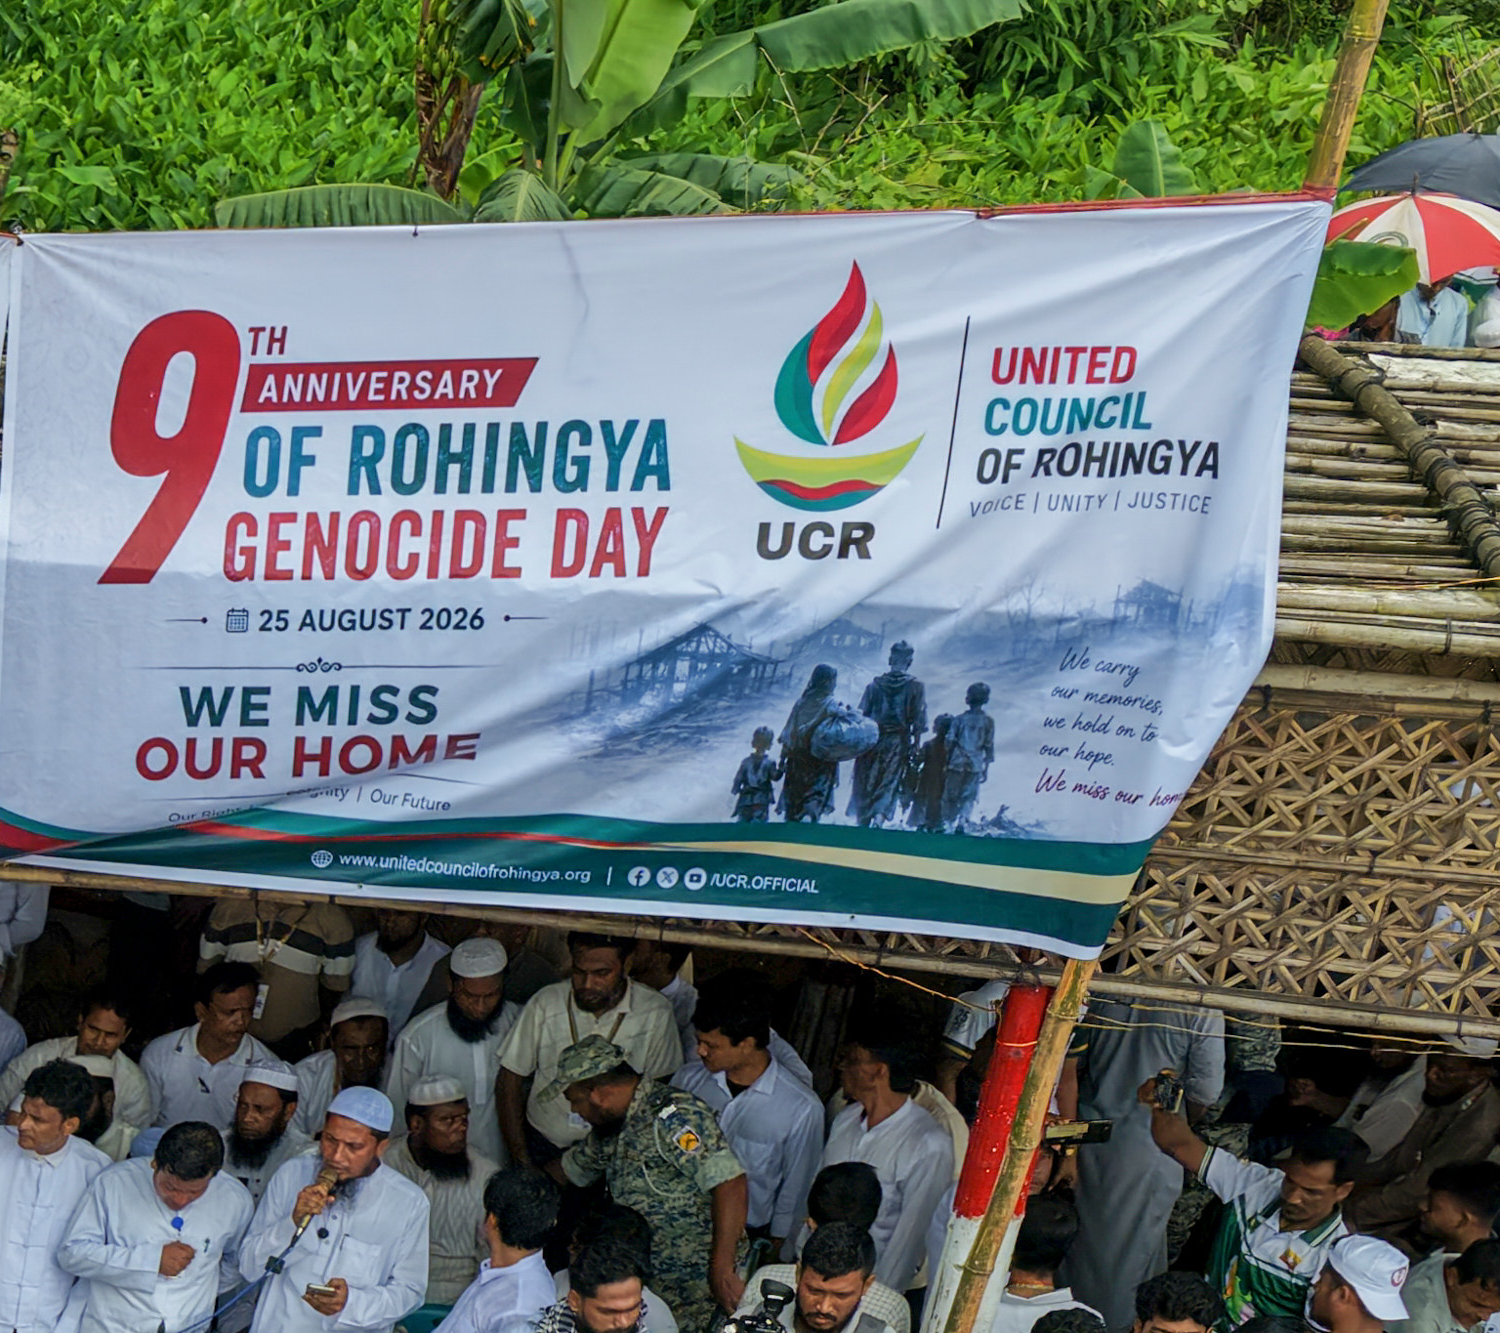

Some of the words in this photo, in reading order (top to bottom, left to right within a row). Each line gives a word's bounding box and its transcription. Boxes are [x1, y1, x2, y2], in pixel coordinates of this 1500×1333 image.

[247, 325, 288, 356] TH
[991, 346, 1138, 386] UNITED
[258, 368, 504, 405] ANNIVERSARY
[983, 390, 1153, 437] COUNCIL
[96, 309, 242, 584] 9
[242, 424, 323, 498] OF
[347, 418, 671, 496] ROHINGYA
[976, 447, 1025, 485] OF
[1030, 439, 1220, 480] ROHINGYA
[969, 493, 1027, 519] VOICE
[1047, 493, 1109, 514] UNITY
[1126, 492, 1212, 515] JUSTICE
[222, 508, 528, 583] GENOCIDE
[549, 506, 669, 579] DAY
[756, 521, 876, 561] UCR
[258, 609, 290, 633] 25
[297, 607, 412, 632] AUGUST
[418, 606, 485, 631] 2026
[1059, 647, 1090, 672] We
[1094, 658, 1140, 687] carry
[178, 685, 272, 727] WE
[294, 684, 439, 726] MISS
[1051, 684, 1079, 699] our
[1083, 691, 1164, 716] memories,
[1043, 714, 1066, 730] we
[1071, 711, 1109, 735] hold
[1116, 724, 1135, 738] on
[1140, 722, 1159, 742] to
[135, 736, 267, 781] OUR
[291, 732, 482, 779] HOME
[1039, 741, 1065, 757] our
[1073, 742, 1115, 771] hope.
[369, 788, 398, 808] Our
[401, 793, 451, 812] Future
[1035, 767, 1067, 793] We
[1072, 781, 1111, 801] miss
[1114, 789, 1144, 806] our
[338, 852, 592, 883] www.unitedcouncilofrohingya.org
[709, 874, 820, 894] /UCR.OFFICIAL
